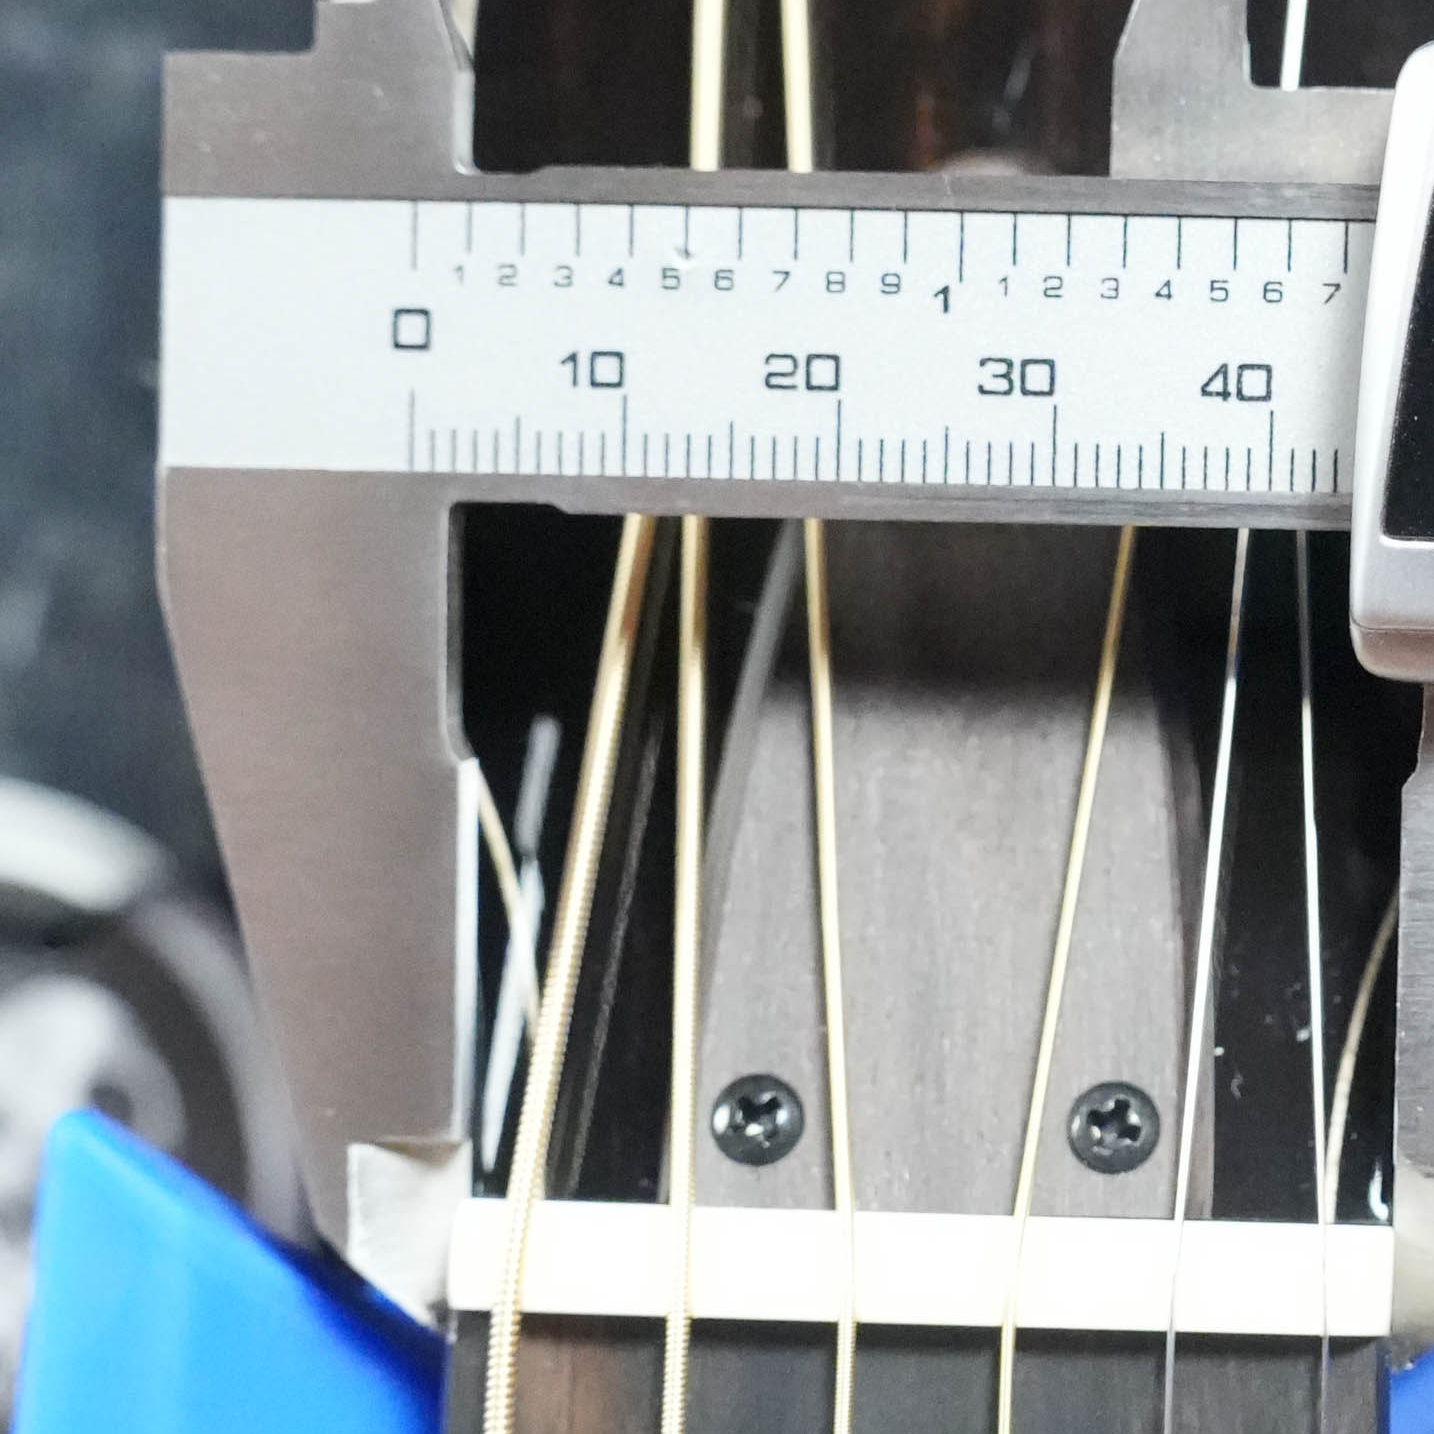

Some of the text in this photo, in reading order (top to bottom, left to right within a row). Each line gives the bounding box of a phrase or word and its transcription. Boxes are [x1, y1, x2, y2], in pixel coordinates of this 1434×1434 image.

[453, 264, 1342, 315] 1 2 3 4 5 6 7 8 9 1 1 2 3 4 5 6 7
[391, 306, 432, 352] 0
[559, 350, 1274, 402] 10 20 30 40
